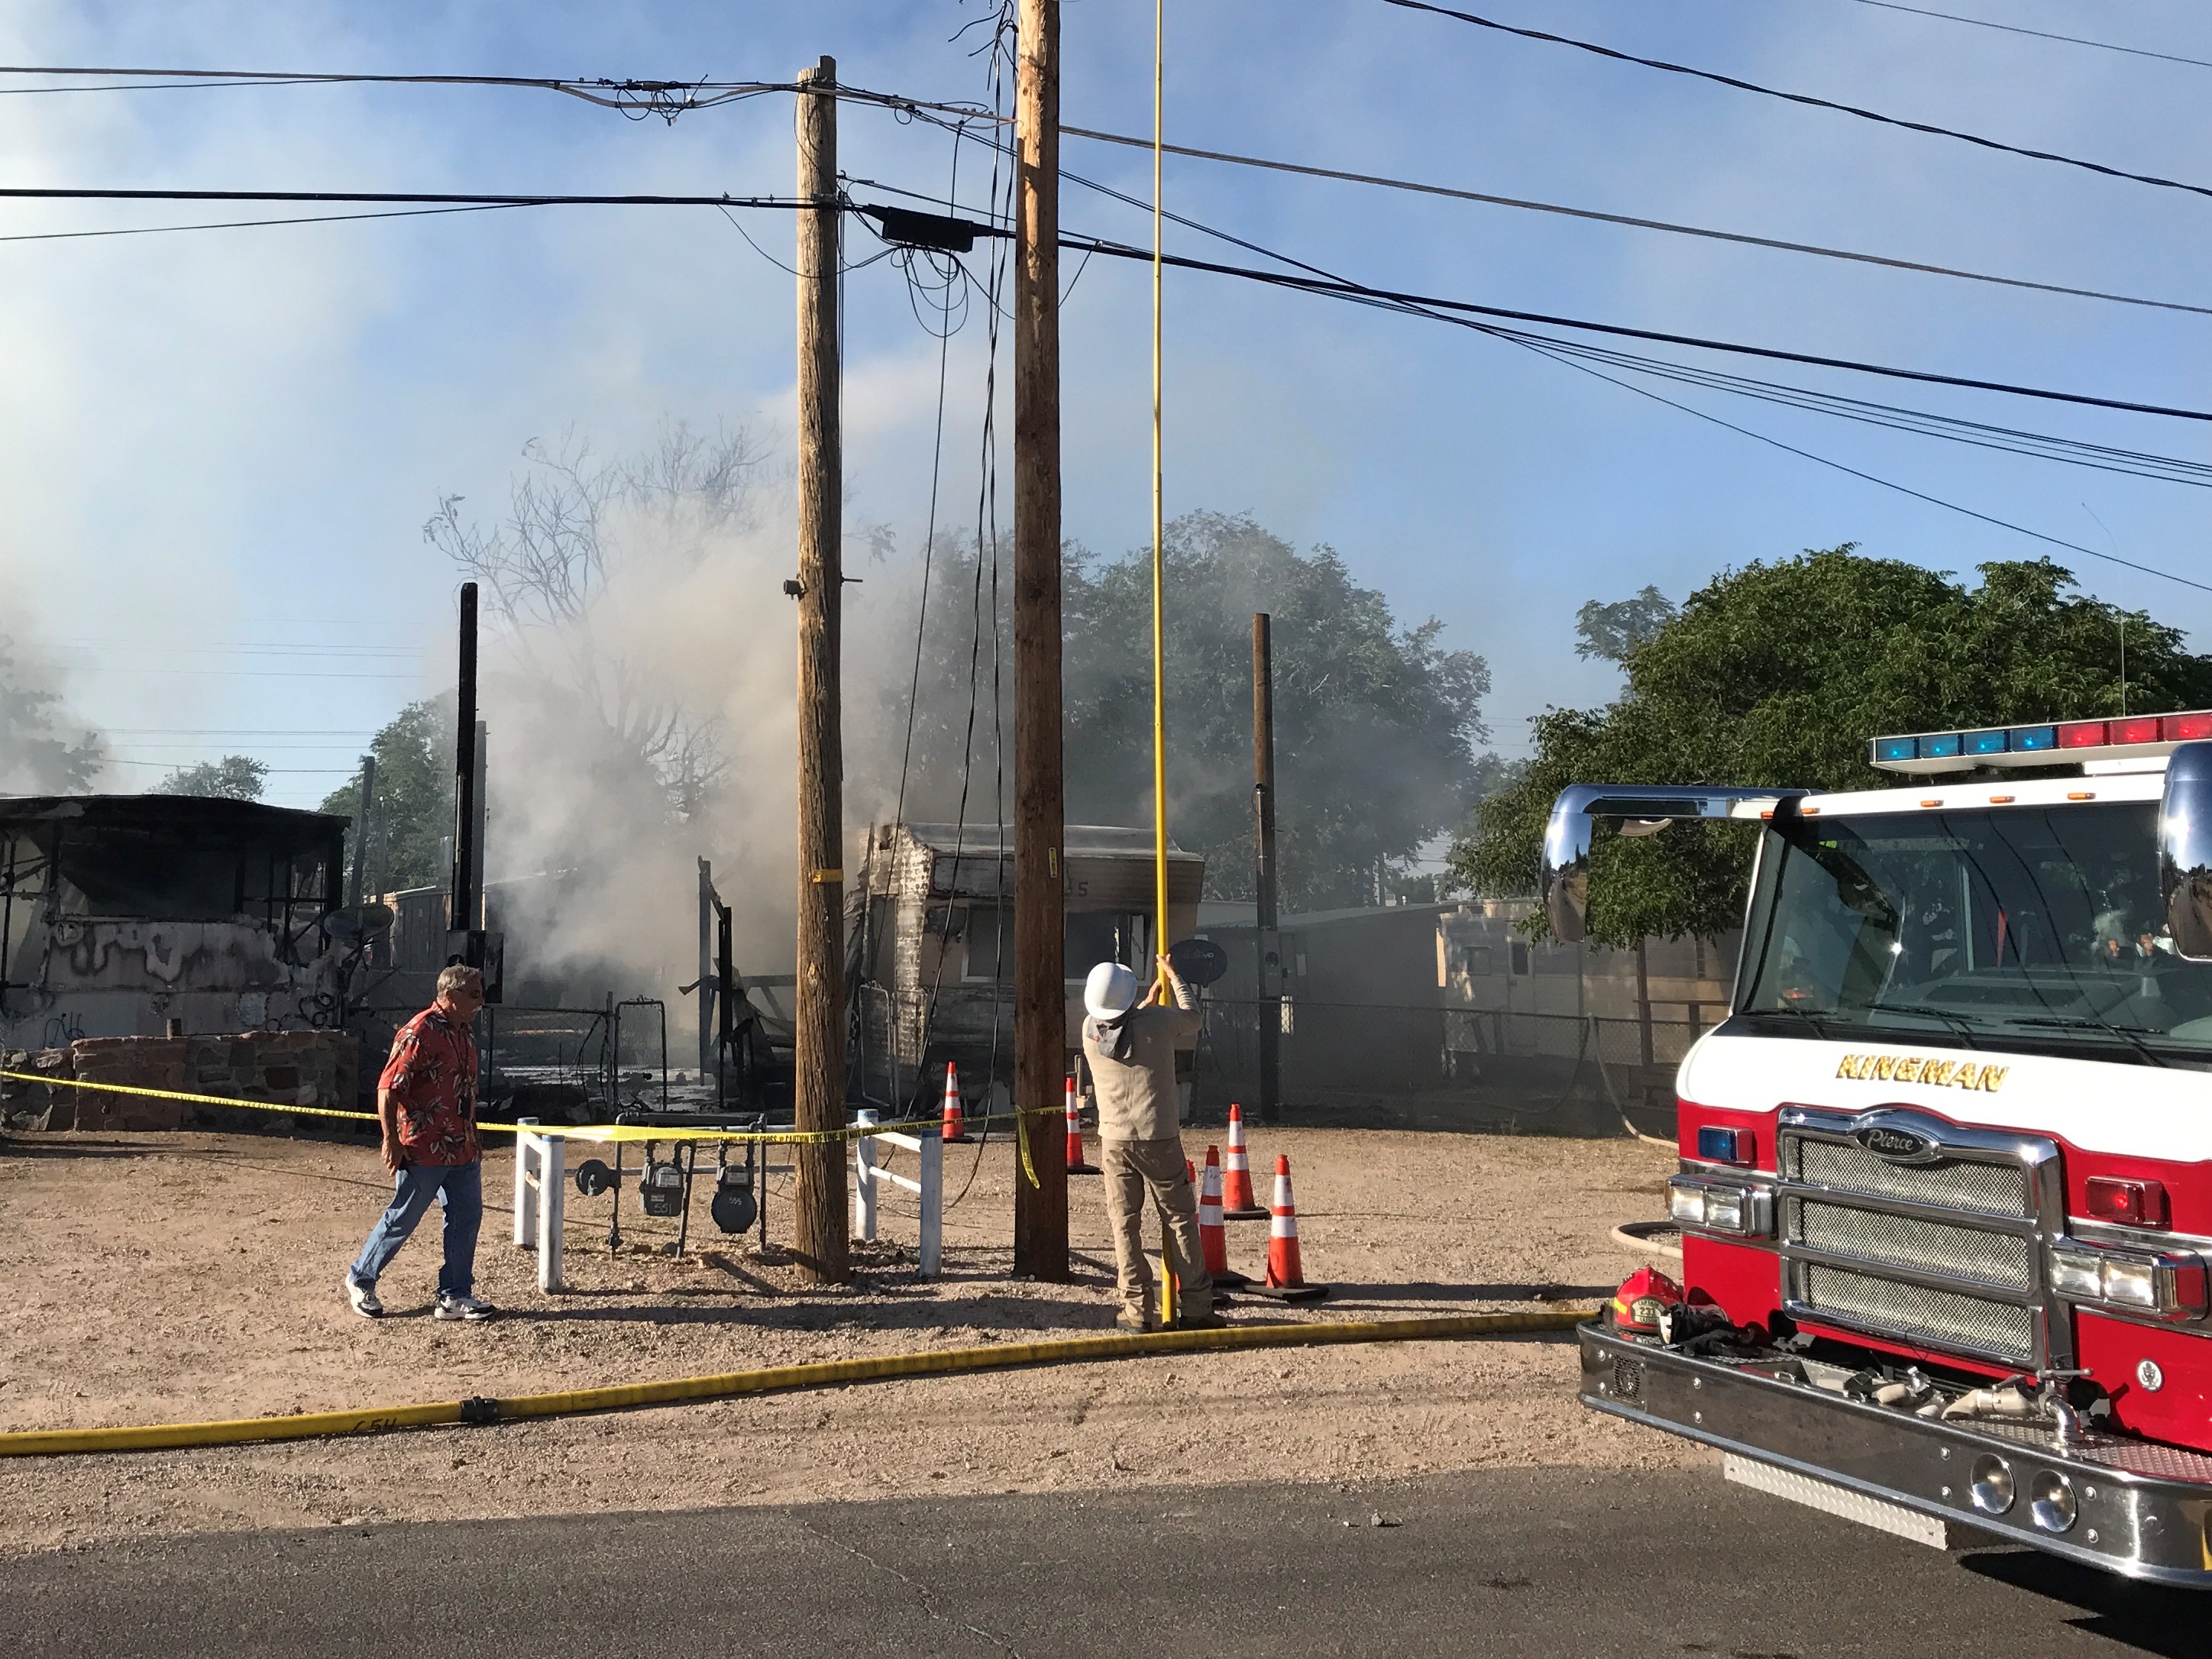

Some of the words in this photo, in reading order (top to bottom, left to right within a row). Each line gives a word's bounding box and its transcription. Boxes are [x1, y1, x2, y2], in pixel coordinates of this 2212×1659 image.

[1835, 1053, 2010, 1092] KINGMAN
[786, 1135, 810, 1143] CAUTION
[810, 1134, 823, 1143] FIRE
[1868, 1129, 1914, 1151] Pierce
[654, 1203, 672, 1215] 551
